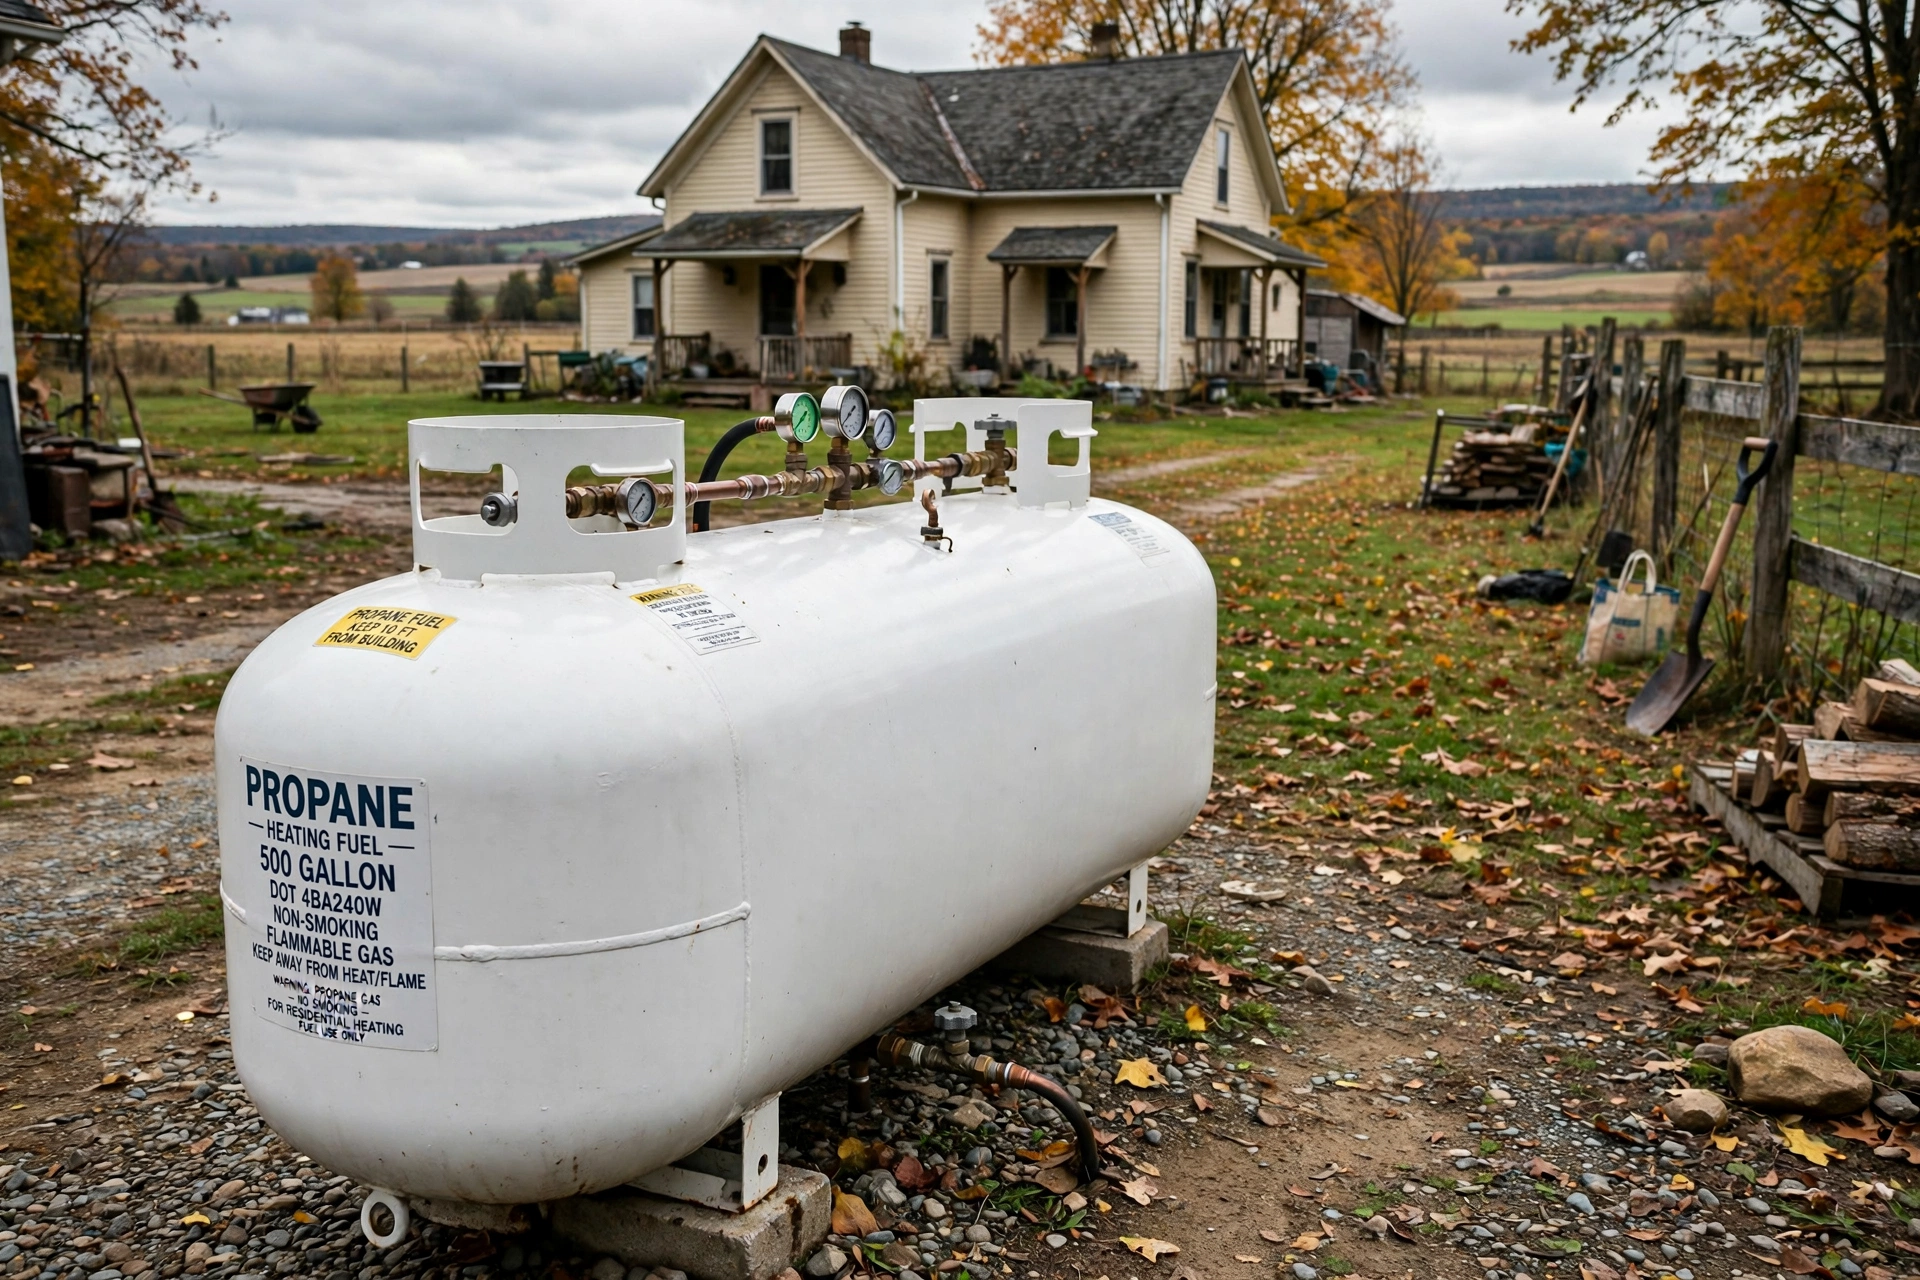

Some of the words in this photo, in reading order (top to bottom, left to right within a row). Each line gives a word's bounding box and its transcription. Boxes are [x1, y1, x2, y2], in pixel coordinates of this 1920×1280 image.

[347, 621, 381, 632] KEEP
[381, 624, 398, 634] 10
[397, 626, 418, 637] FT
[348, 609, 412, 623] PROPANE
[408, 613, 445, 629] FUEL
[323, 631, 360, 644] FROM
[358, 634, 418, 654] BUILDING
[246, 764, 415, 830] PROPANE
[267, 819, 330, 851] HEATING
[337, 832, 383, 856] FUEL
[260, 844, 292, 877] 500
[299, 853, 396, 892] GALLON
[270, 879, 296, 904] DOT
[302, 887, 382, 917] 4BA240W
[273, 904, 379, 941] NON-SMOKING
[267, 924, 352, 962] FLAMMABLE
[358, 944, 394, 967] GAS
[252, 942, 273, 963] KEEP
[276, 951, 302, 972] AWAY
[306, 959, 339, 981] FROM
[342, 966, 426, 990] HEAT/FLAME
[267, 997, 284, 1014] FOR
[286, 1004, 351, 1030] RESIDENTIAL
[353, 1019, 404, 1036] HEATING
[297, 994, 309, 1007] NO
[312, 997, 358, 1017] SMOKING
[361, 992, 381, 1006] GAS
[298, 1020, 318, 1035] FUEL
[321, 1027, 338, 1039] USE
[341, 1030, 366, 1043] ONLY
